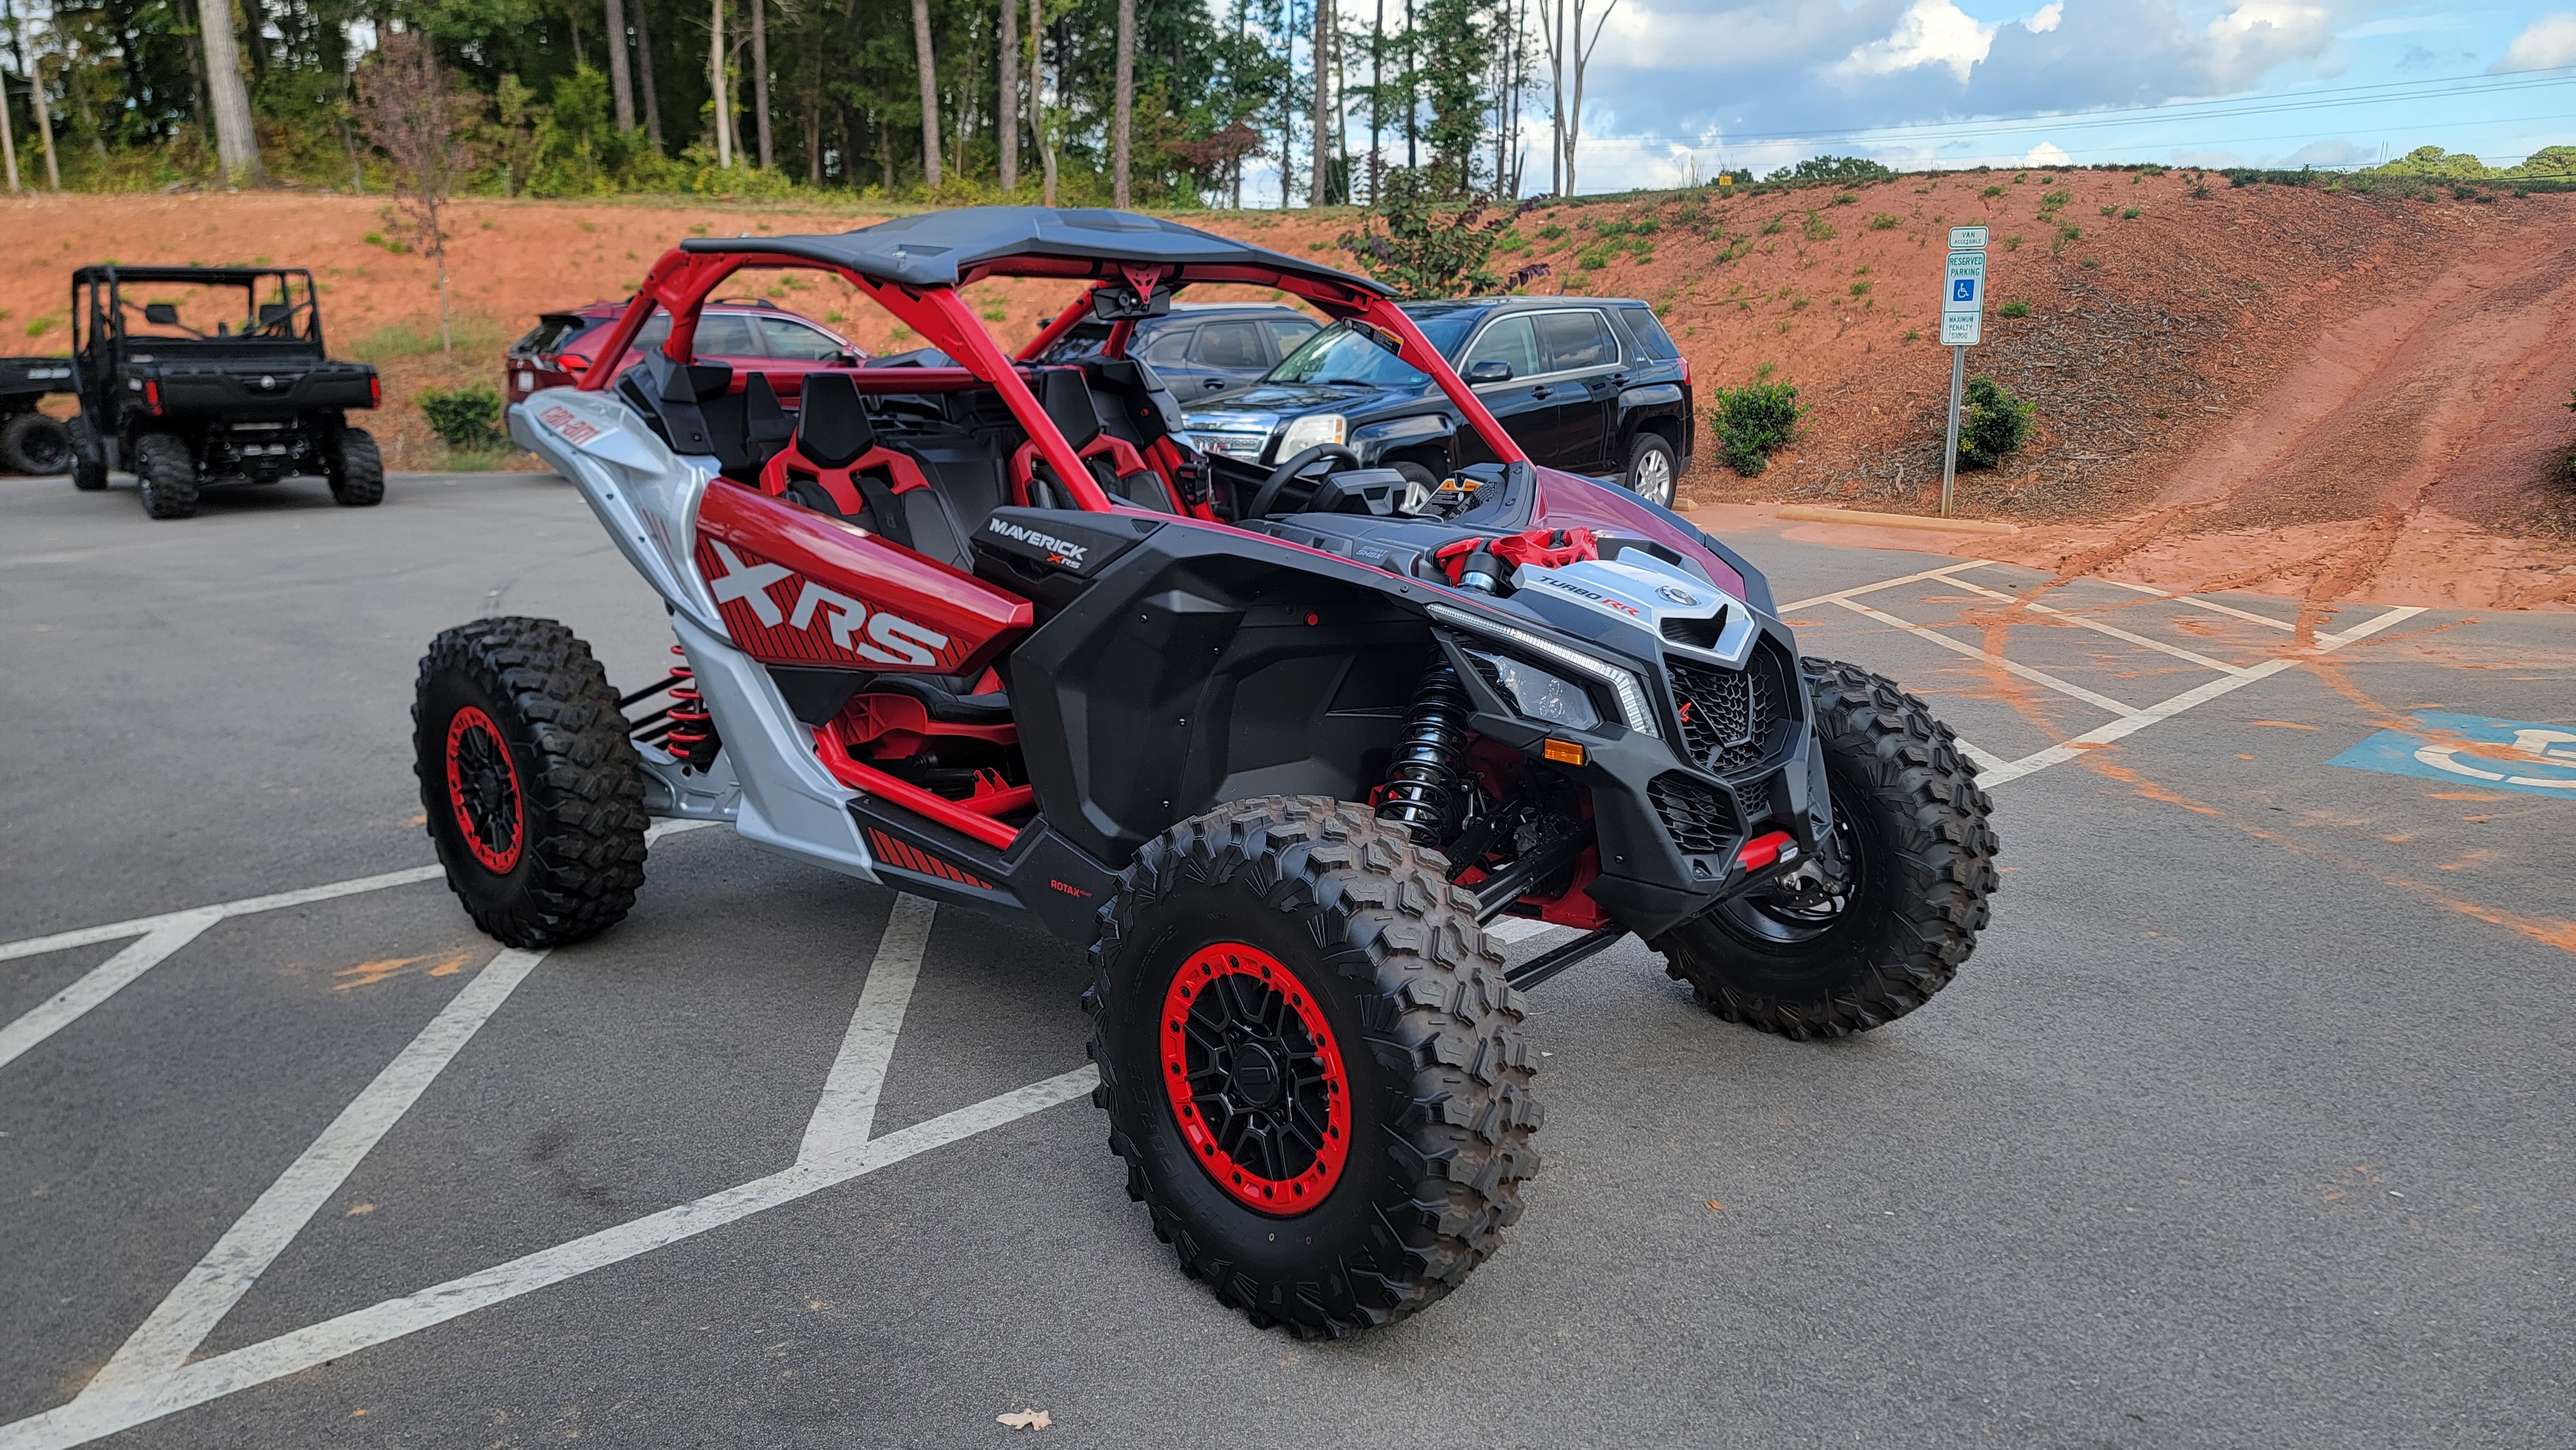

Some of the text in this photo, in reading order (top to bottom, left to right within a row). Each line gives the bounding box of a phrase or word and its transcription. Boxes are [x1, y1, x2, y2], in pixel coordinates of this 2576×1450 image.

[1949, 256, 1983, 266] RESERVED
[1951, 268, 1980, 277] PARKING
[989, 517, 1088, 561] MAVERICK
[1355, 549, 1385, 560] SHOX
[1361, 545, 1389, 555] SMART
[1046, 552, 1081, 569] XRS
[709, 538, 949, 666] XRS
[1540, 576, 1640, 617] TURBO RR
[1050, 879, 1080, 898] ROTAX
